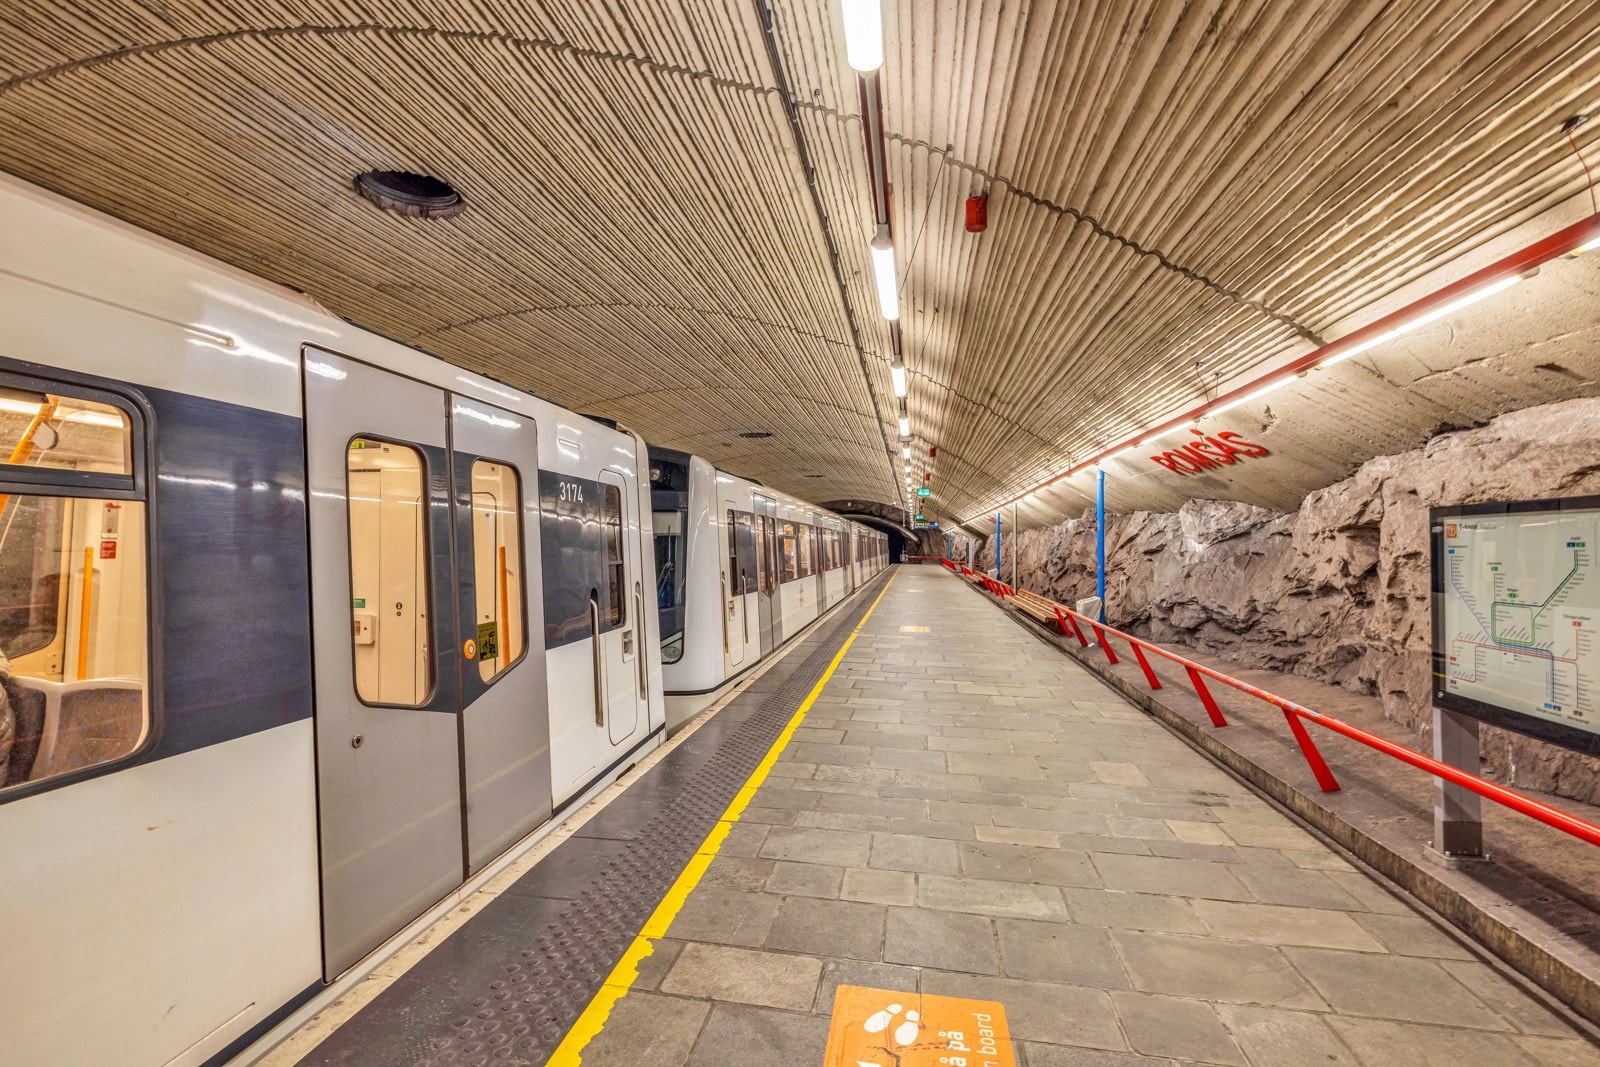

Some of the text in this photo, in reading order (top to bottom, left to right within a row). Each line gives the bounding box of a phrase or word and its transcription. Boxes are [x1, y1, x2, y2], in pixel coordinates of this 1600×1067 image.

[1150, 428, 1269, 476] ROMSÅS
[560, 481, 583, 503] 3174
[938, 1031, 971, 1052] på
[971, 1013, 997, 1055] board
